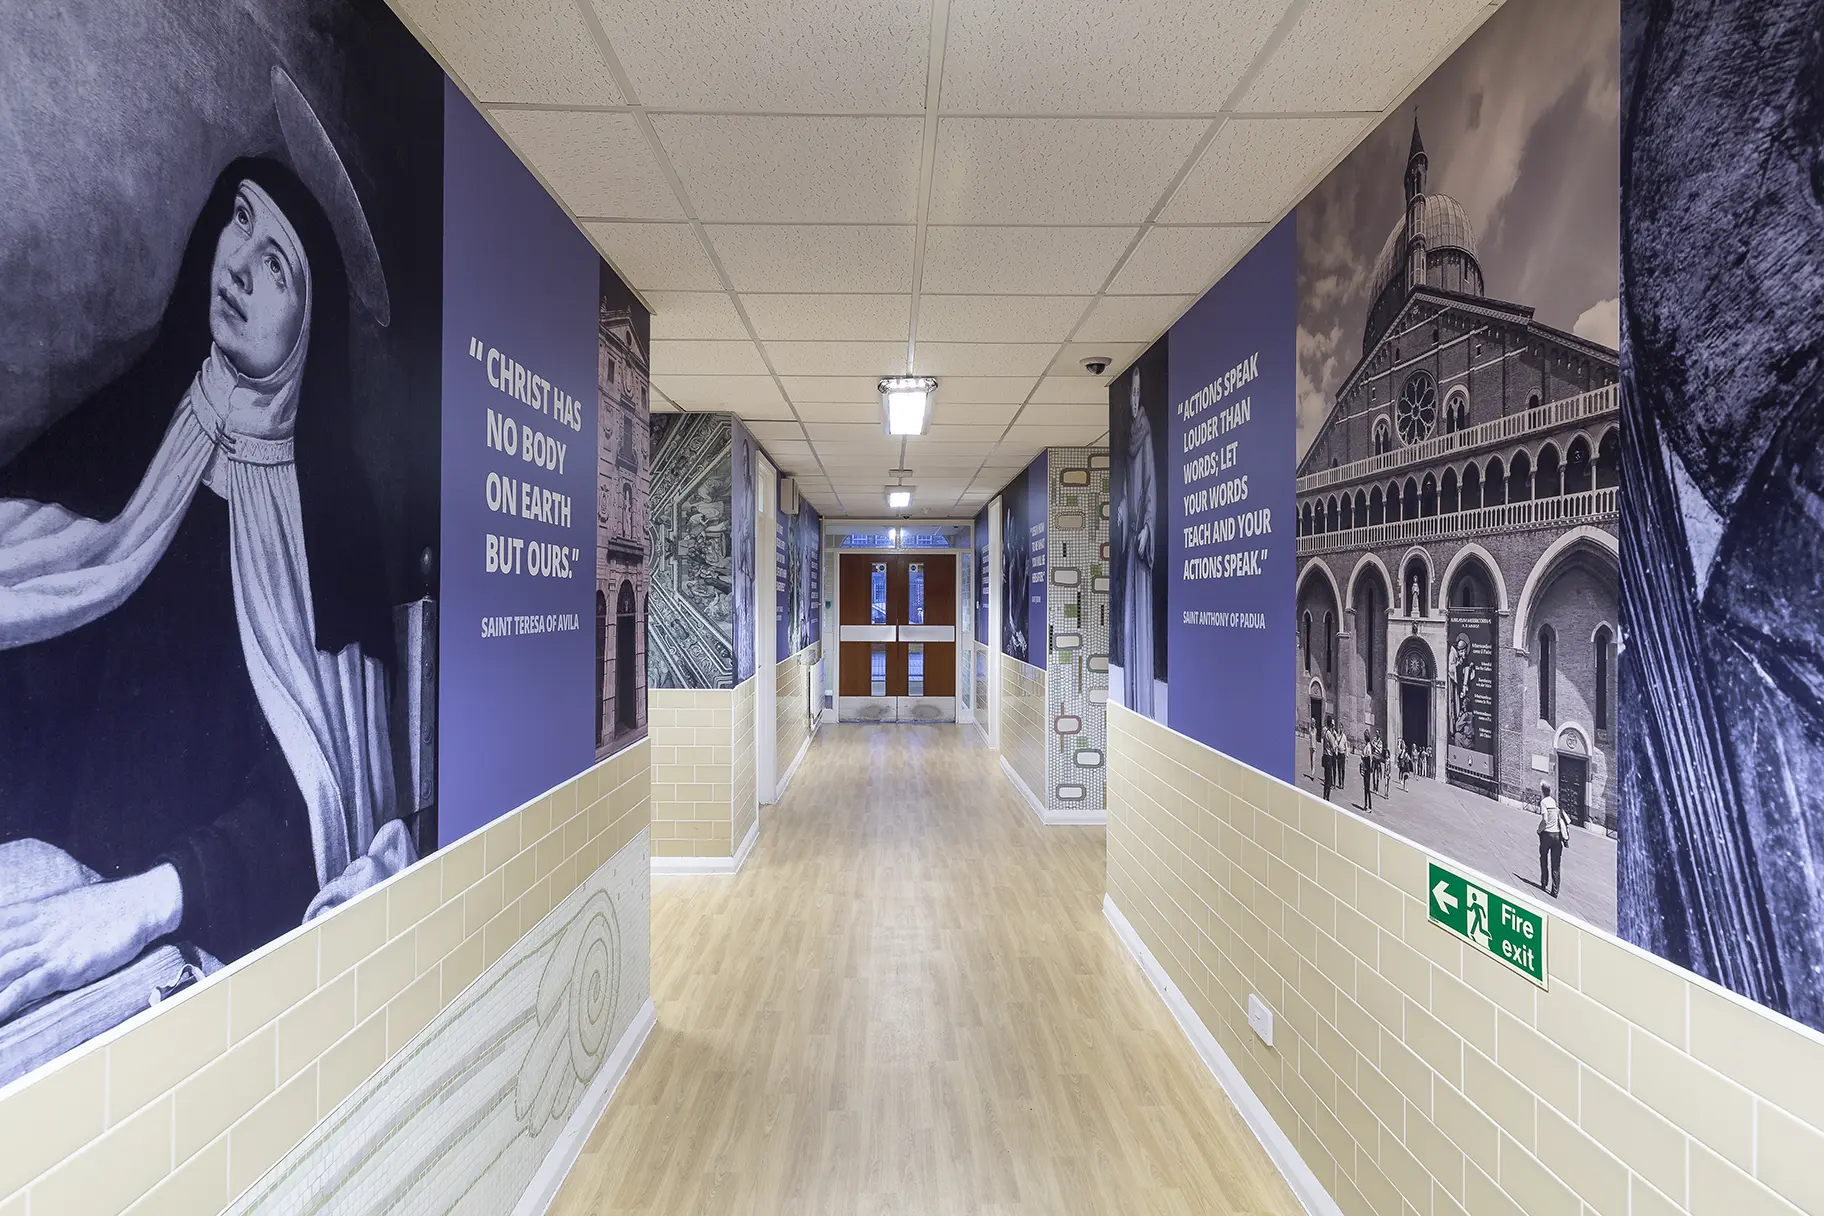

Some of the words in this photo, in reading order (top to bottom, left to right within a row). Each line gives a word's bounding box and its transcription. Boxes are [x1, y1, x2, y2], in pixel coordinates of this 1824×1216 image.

[469, 336, 551, 415] "CHRIST
[553, 386, 582, 432] HAS
[1177, 377, 1223, 422] "ACTIONS
[1223, 351, 1259, 397] SPEAK
[486, 408, 518, 456] NO
[522, 424, 567, 475] BODY
[1183, 415, 1219, 453] LOUDER
[1219, 396, 1251, 435] THAN
[1183, 451, 1219, 485] WORDS;
[1220, 441, 1239, 471] LET
[486, 472, 517, 516] ON
[521, 482, 571, 528] EARTH
[1183, 489, 1208, 517] YOUR
[1208, 474, 1248, 510] WORDS
[1183, 522, 1211, 549] TEACH
[1212, 517, 1236, 544] AND
[1237, 508, 1272, 539] YOUR
[485, 533, 524, 575] BUT
[527, 540, 580, 579] OURS."
[1183, 555, 1223, 581] ACTIONS
[1223, 548, 1268, 578] SPEAK."
[481, 616, 513, 638] SAINT
[513, 615, 546, 635] TERESA
[546, 614, 558, 633] OF
[557, 613, 580, 632] AVILA
[1182, 610, 1199, 625] SAINT
[1199, 611, 1230, 627] ANTHONY
[1229, 612, 1240, 628] OF
[1239, 612, 1266, 630] PADUA
[1501, 903, 1534, 940] Fire
[1501, 939, 1535, 972] exit
